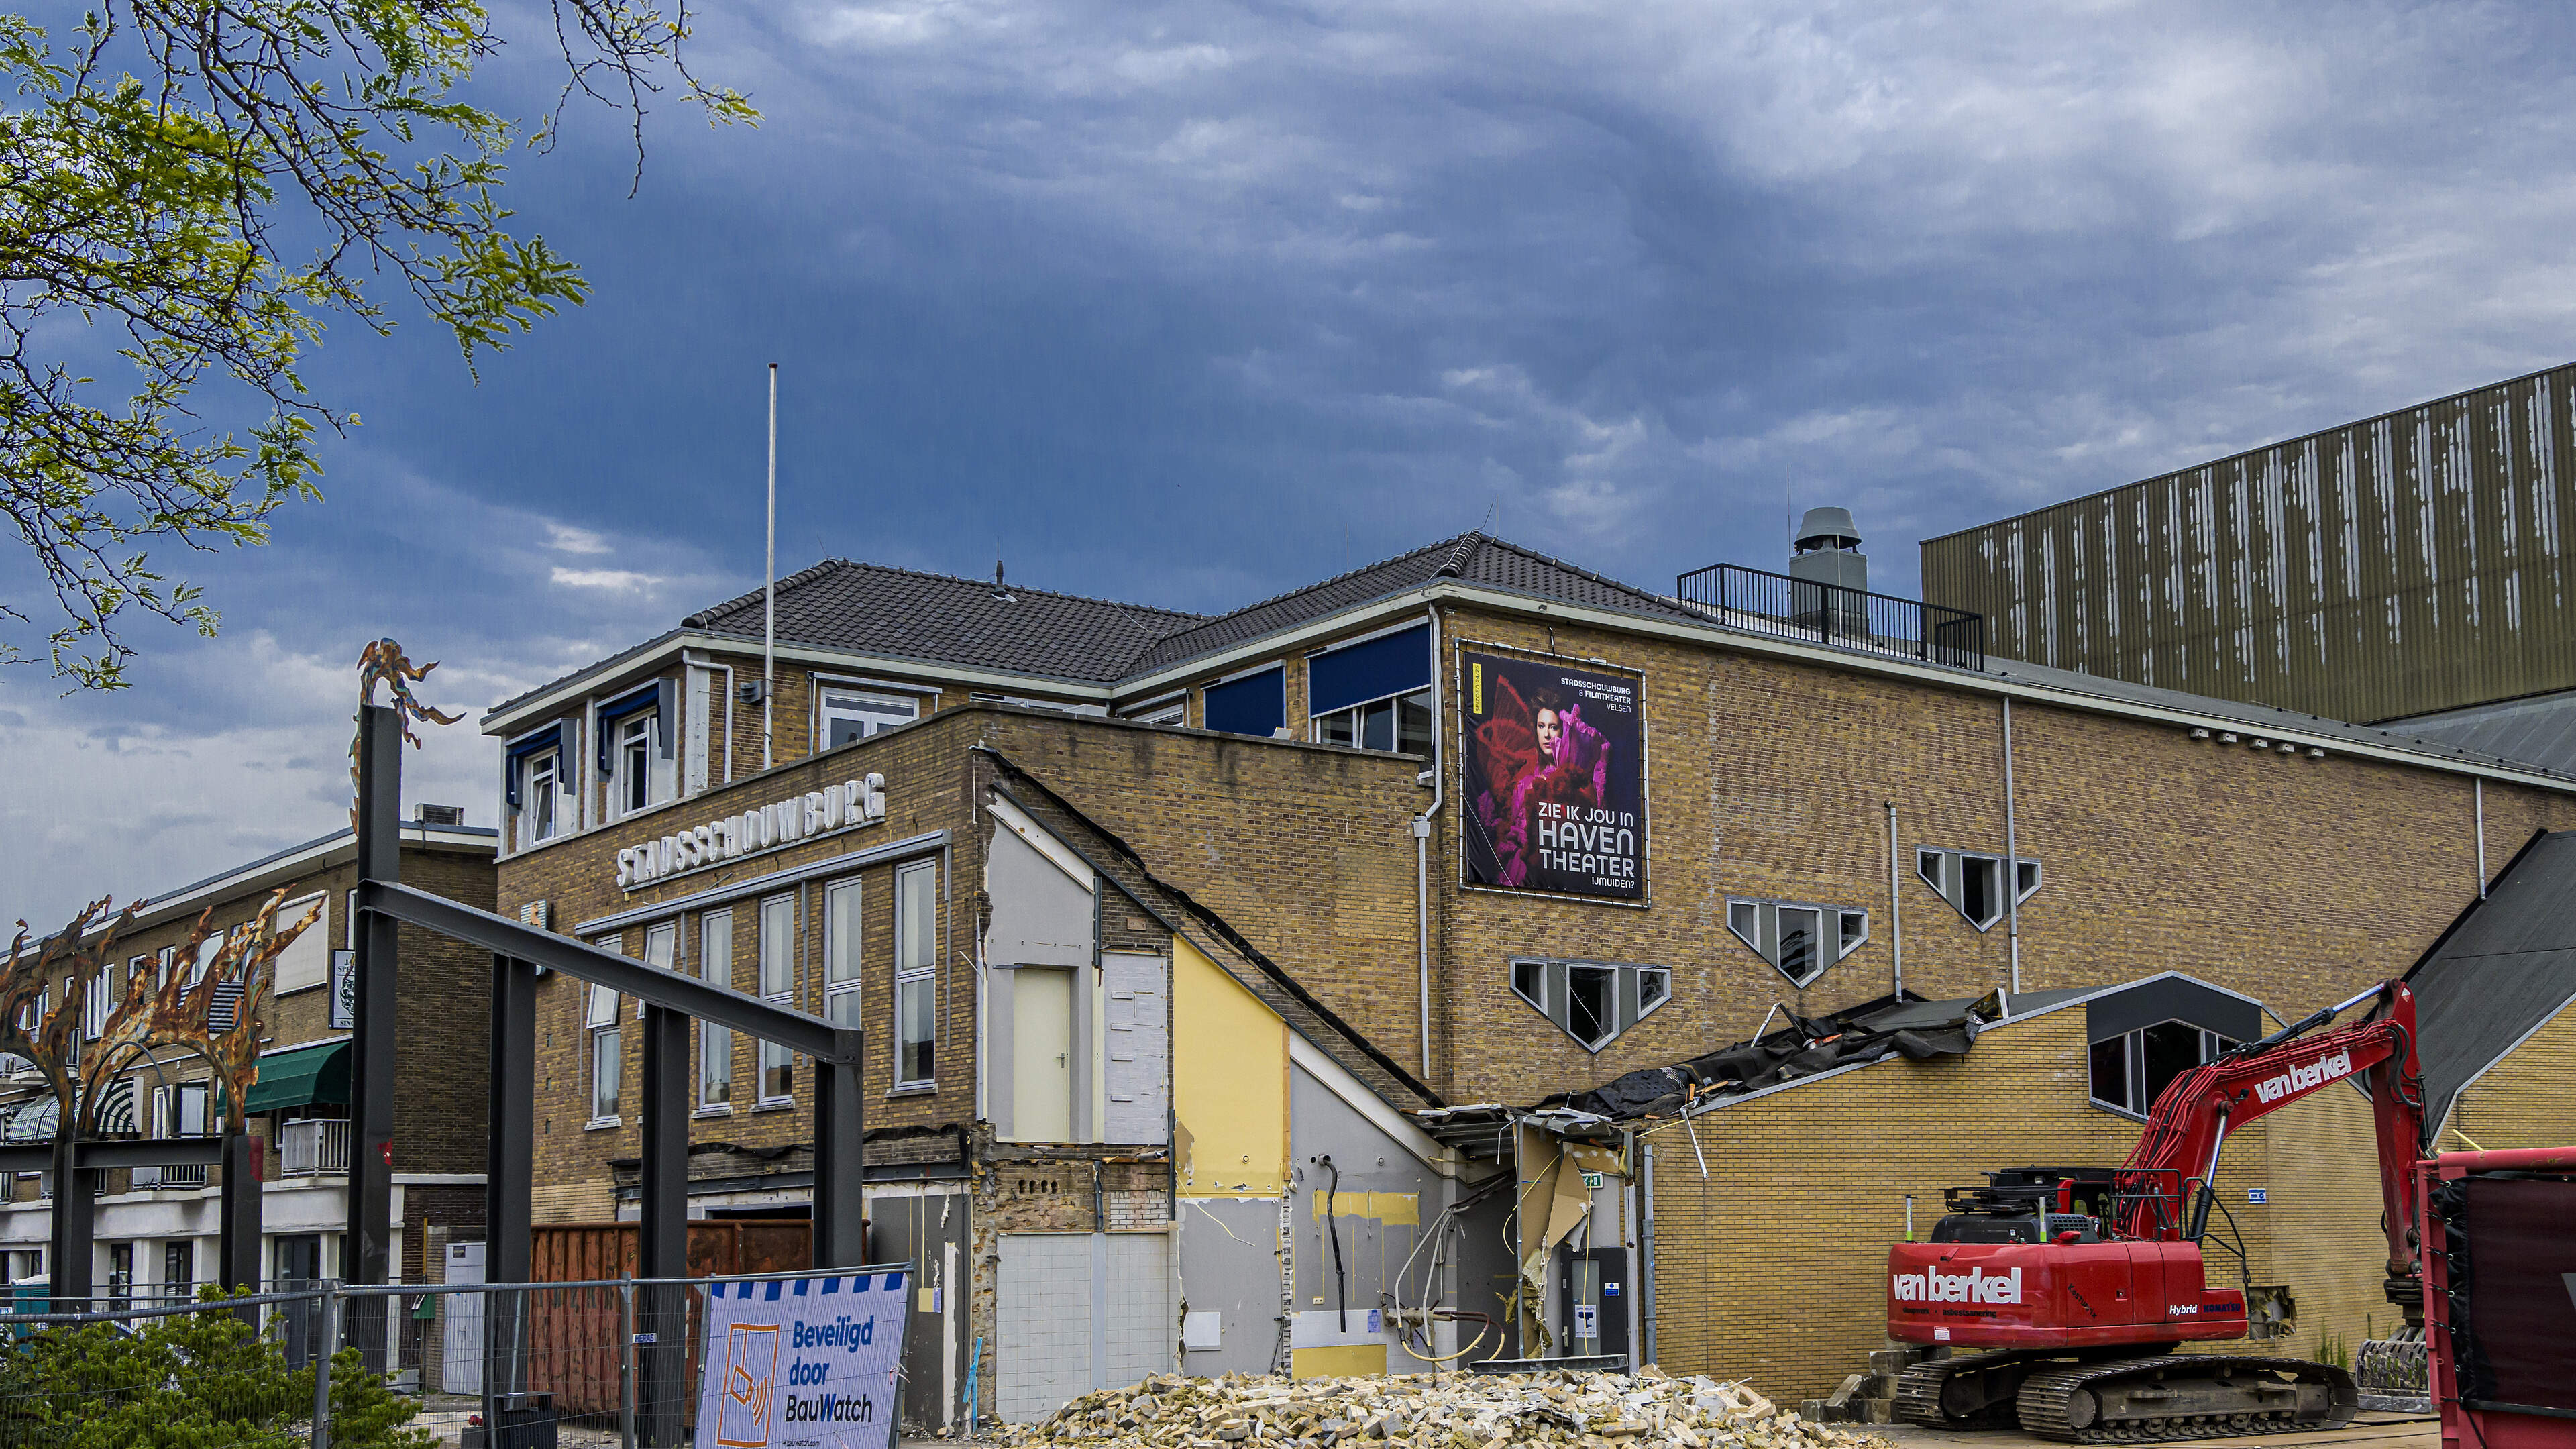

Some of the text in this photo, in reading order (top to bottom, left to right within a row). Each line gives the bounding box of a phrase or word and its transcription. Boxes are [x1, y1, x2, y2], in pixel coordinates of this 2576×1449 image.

[1561, 677, 1631, 695] STADSSCHOUWBURG
[1578, 689, 1631, 704] & FILMTHEATER
[1606, 702, 1631, 712] VELSEN
[1538, 802, 1633, 827] ZIE IK JOU IN
[617, 773, 885, 887] STADSSCHOUWBURG
[1538, 819, 1634, 855] HAVEN
[1539, 849, 1635, 877] THEATER
[1592, 876, 1635, 889] IJMUIDEN?
[2254, 1046, 2352, 1104] van berkel
[1893, 1265, 2021, 1304] van berkel
[1943, 1308, 1997, 1319] asbestsanering
[2169, 1304, 2198, 1316] Hybrid
[2203, 1302, 2241, 1313] KOMATSU
[793, 1315, 874, 1353] Beveiligd
[789, 1356, 830, 1386] door
[785, 1393, 872, 1422] BauWatch
